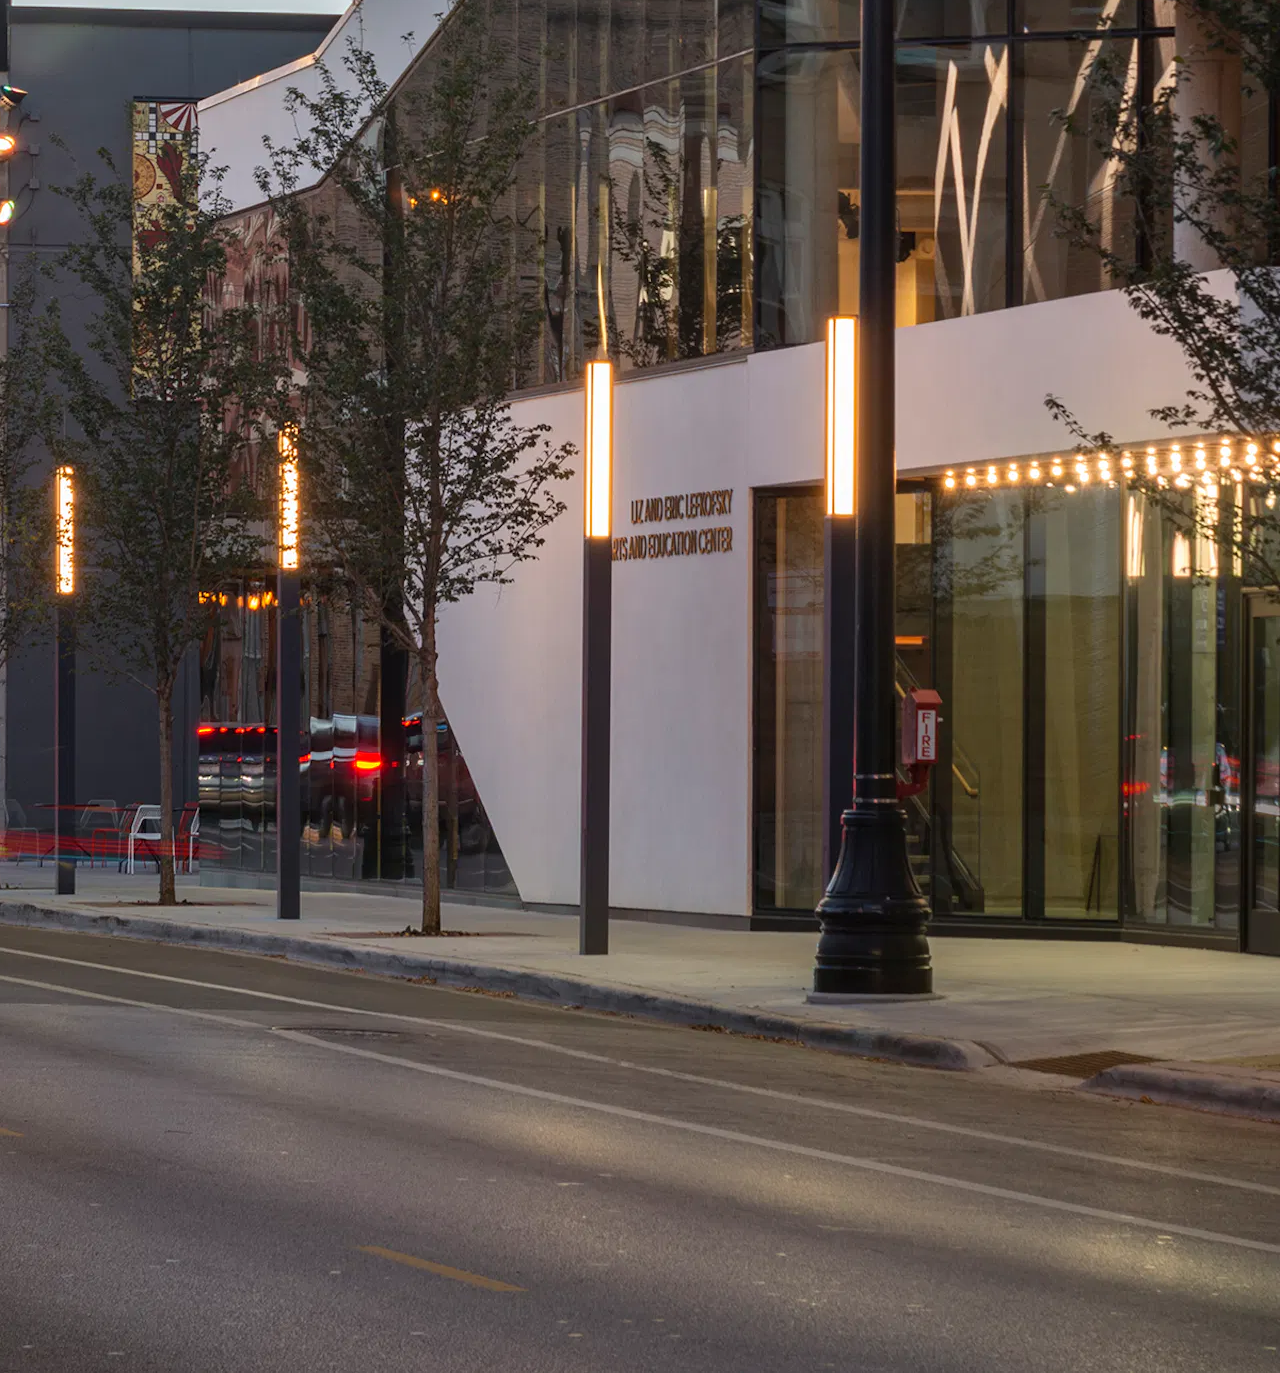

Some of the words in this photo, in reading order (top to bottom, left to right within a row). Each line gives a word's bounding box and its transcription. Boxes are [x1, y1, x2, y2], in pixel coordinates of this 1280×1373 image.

[631, 499, 644, 525] LIZ
[645, 496, 663, 522] AND
[664, 494, 685, 521] ERIC
[685, 488, 734, 519] LEFKOFSKY
[611, 537, 628, 562] RTS
[628, 534, 647, 560] AND
[647, 529, 698, 559] EDUCATION
[698, 526, 733, 555] CENTER
[921, 712, 932, 758] FIRE
